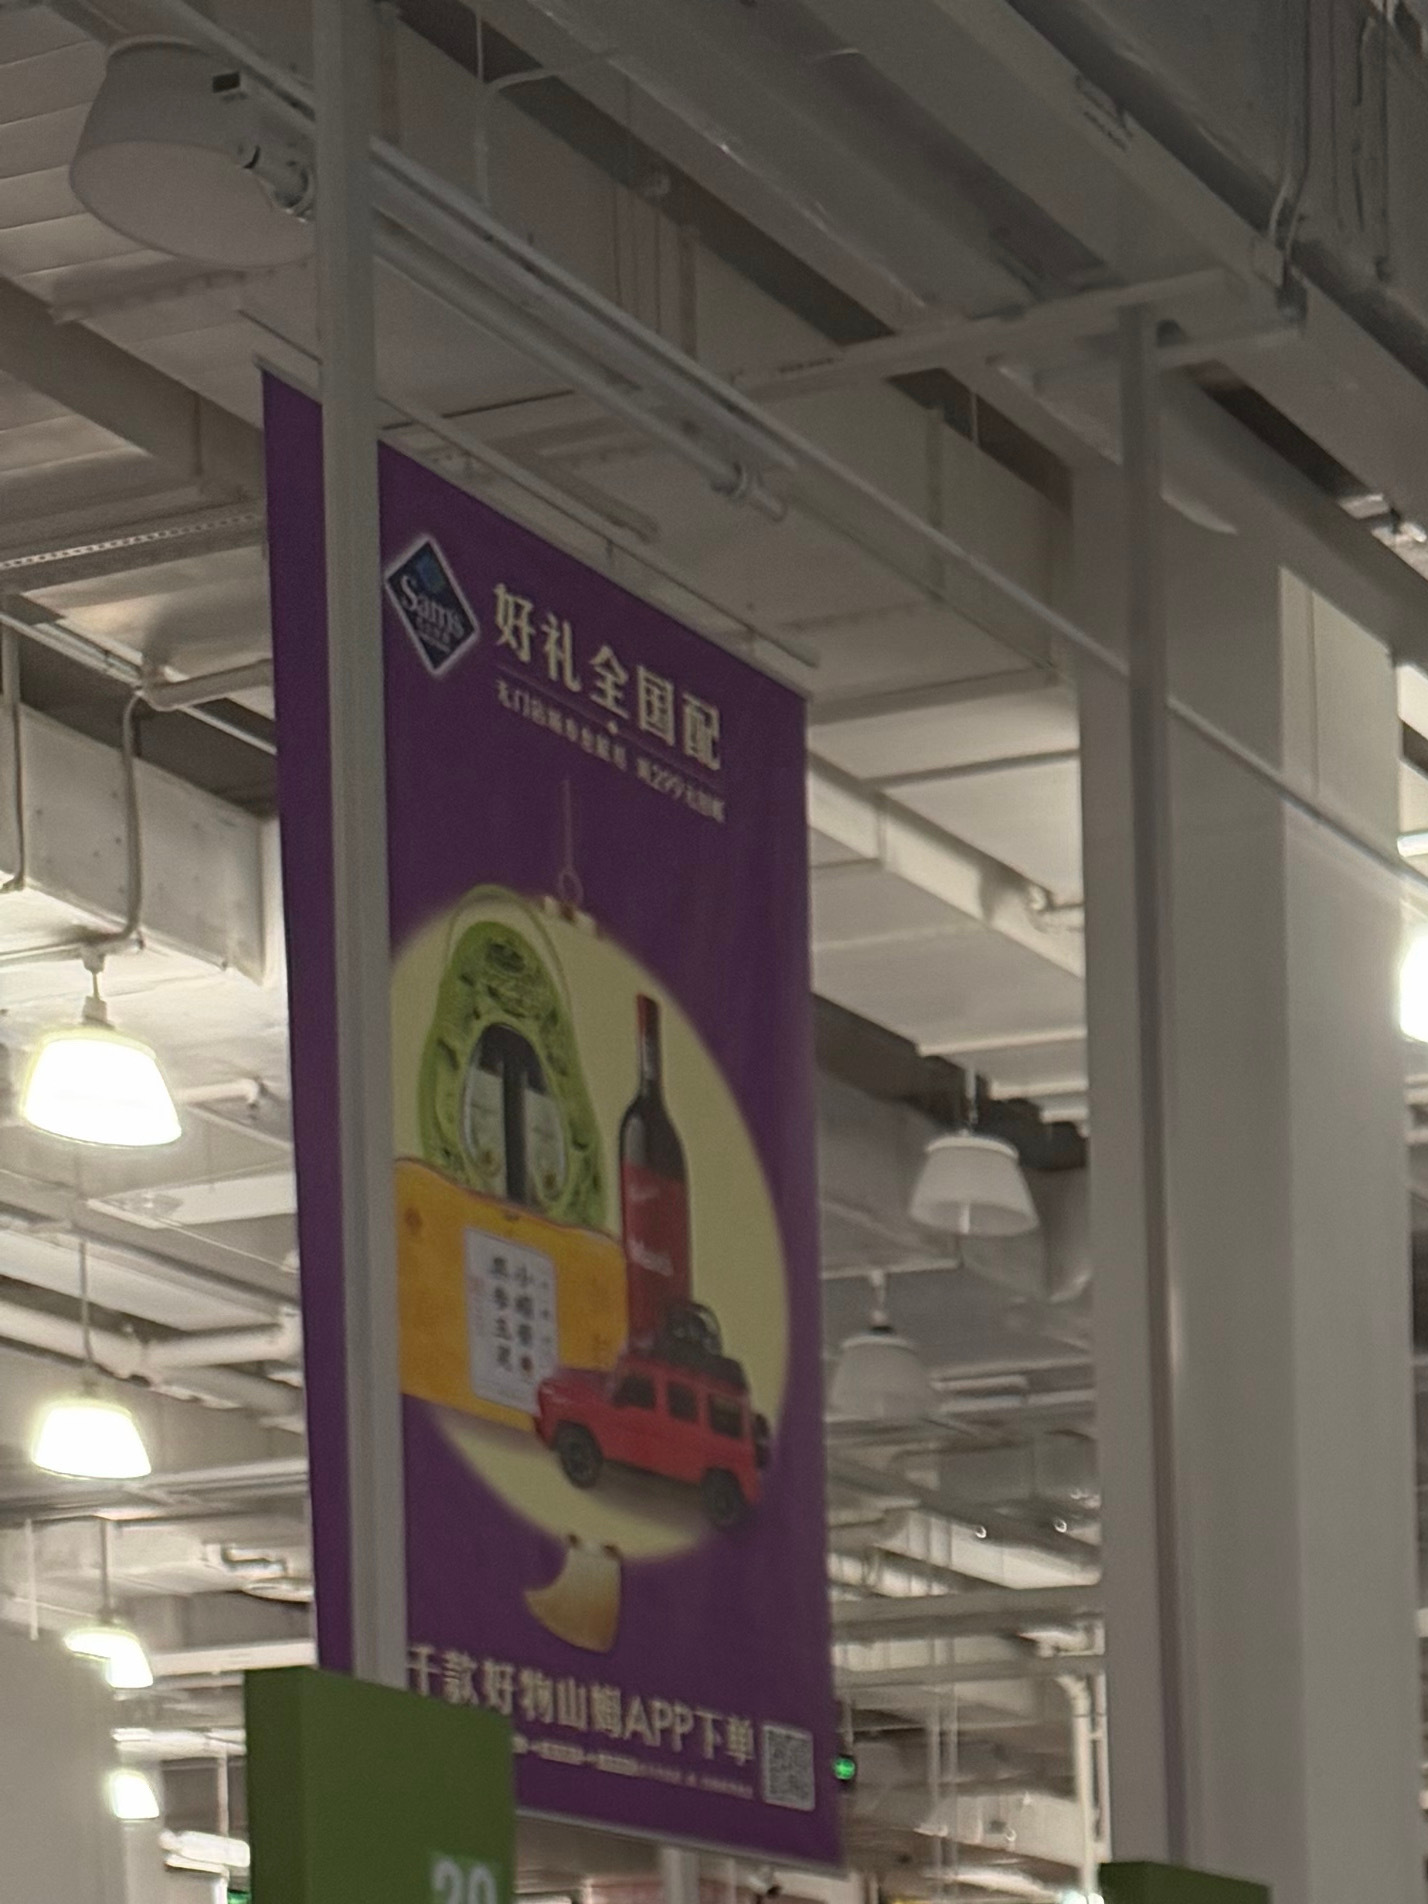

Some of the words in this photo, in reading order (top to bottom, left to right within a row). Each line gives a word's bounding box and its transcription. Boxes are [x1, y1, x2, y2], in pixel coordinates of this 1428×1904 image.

[494, 583, 722, 771] 好礼全国配
